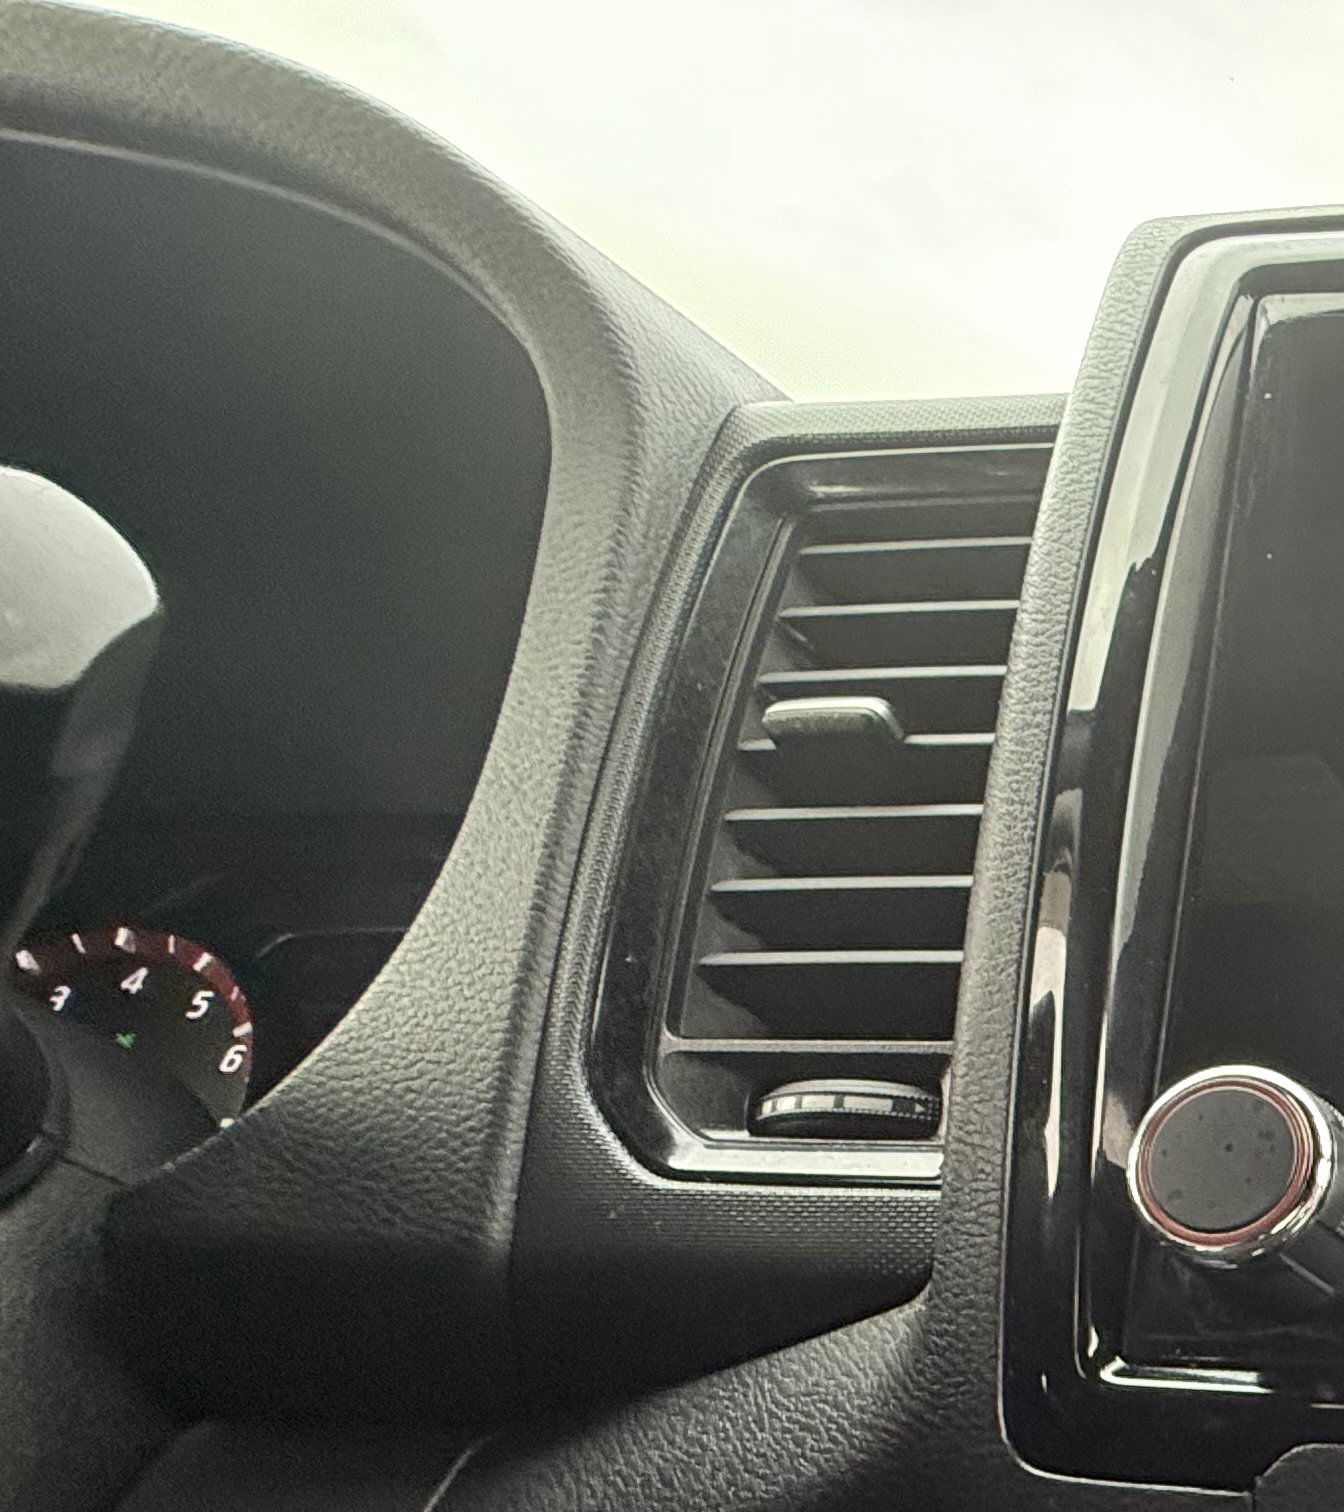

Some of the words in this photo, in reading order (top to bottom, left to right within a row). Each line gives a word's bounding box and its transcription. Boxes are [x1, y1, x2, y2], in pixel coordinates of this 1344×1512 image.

[119, 967, 149, 996] 4
[48, 985, 72, 1013] 3
[184, 990, 215, 1021] 5
[218, 1044, 248, 1075] 6
